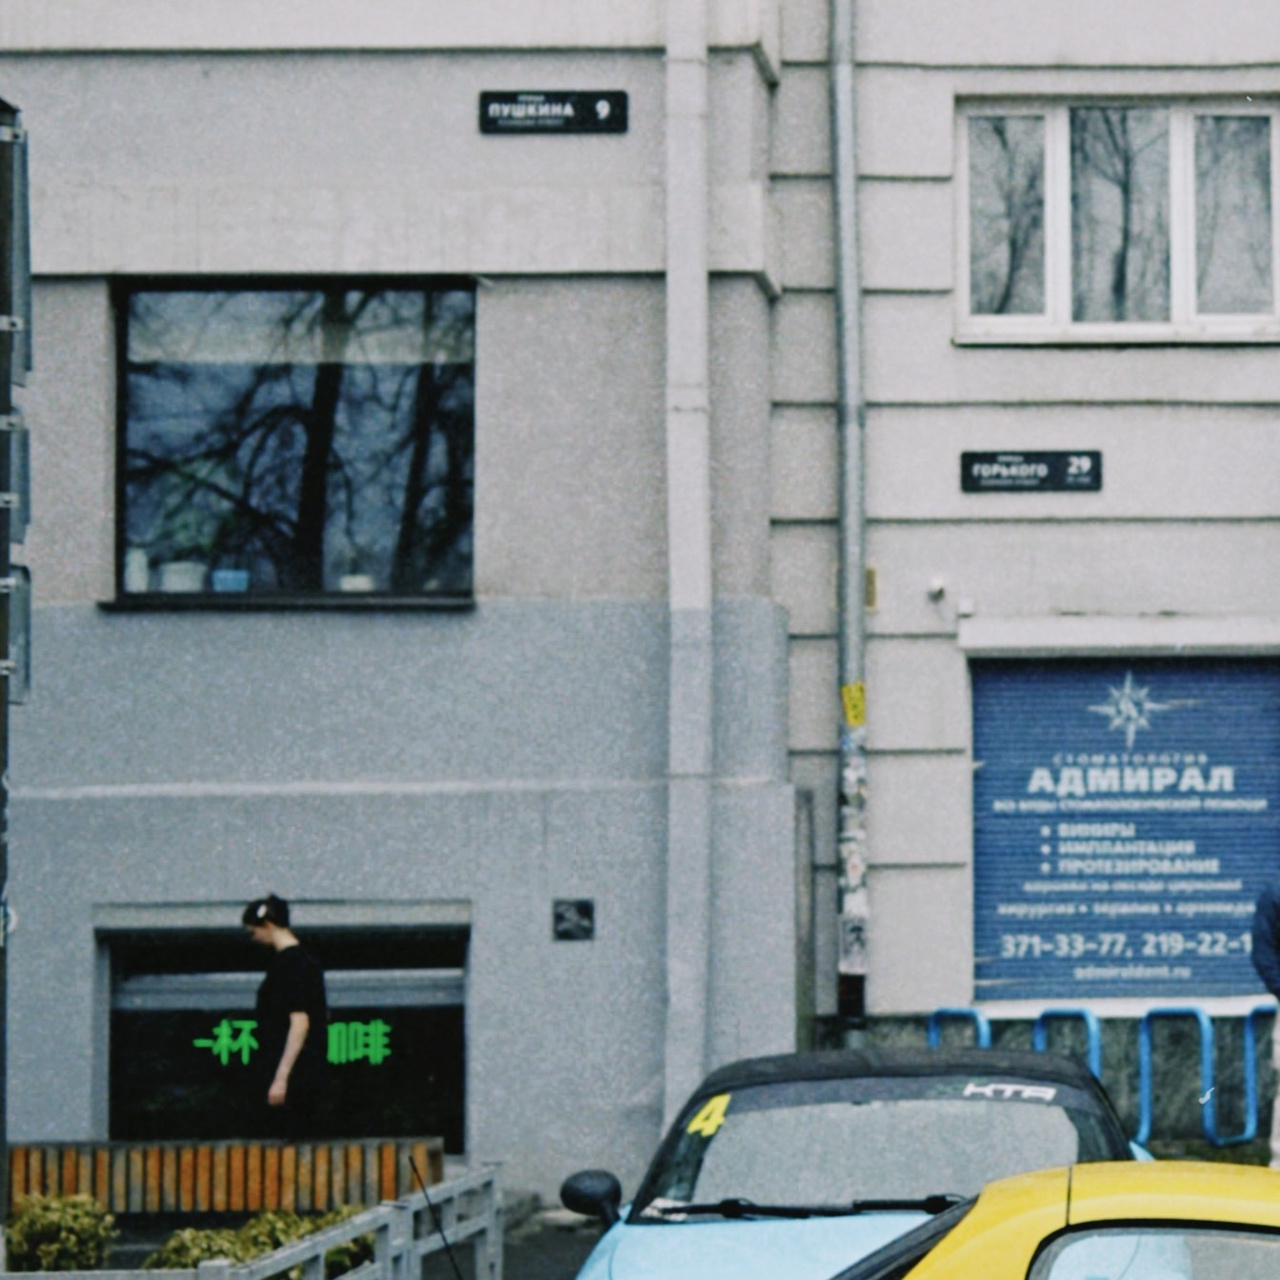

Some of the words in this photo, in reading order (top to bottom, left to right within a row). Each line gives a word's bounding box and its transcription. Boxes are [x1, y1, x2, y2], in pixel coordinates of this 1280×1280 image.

[488, 102, 575, 118] ПУШКИНА
[595, 99, 611, 120] 9
[972, 462, 1049, 478] ГОРЬКОГО
[1067, 455, 1092, 475] 29
[1053, 753, 1208, 766] СТОМАТОЛОГИЯ
[1027, 765, 1236, 797] АДМИРАЛ
[1058, 840, 1195, 855] ИМПЛАНТАЦИЯ
[1058, 858, 1220, 874] ПРОТЕЗИРОВАНИЕ
[997, 902, 1076, 919] хирургия
[1093, 902, 1160, 918] терапия
[1175, 901, 1256, 918] ортопеди
[1000, 933, 1133, 958] 371-33-77,
[1141, 931, 1253, 956] 219-22-1
[1073, 963, 1192, 980] admiraldent.ru
[686, 1092, 732, 1138] 4
